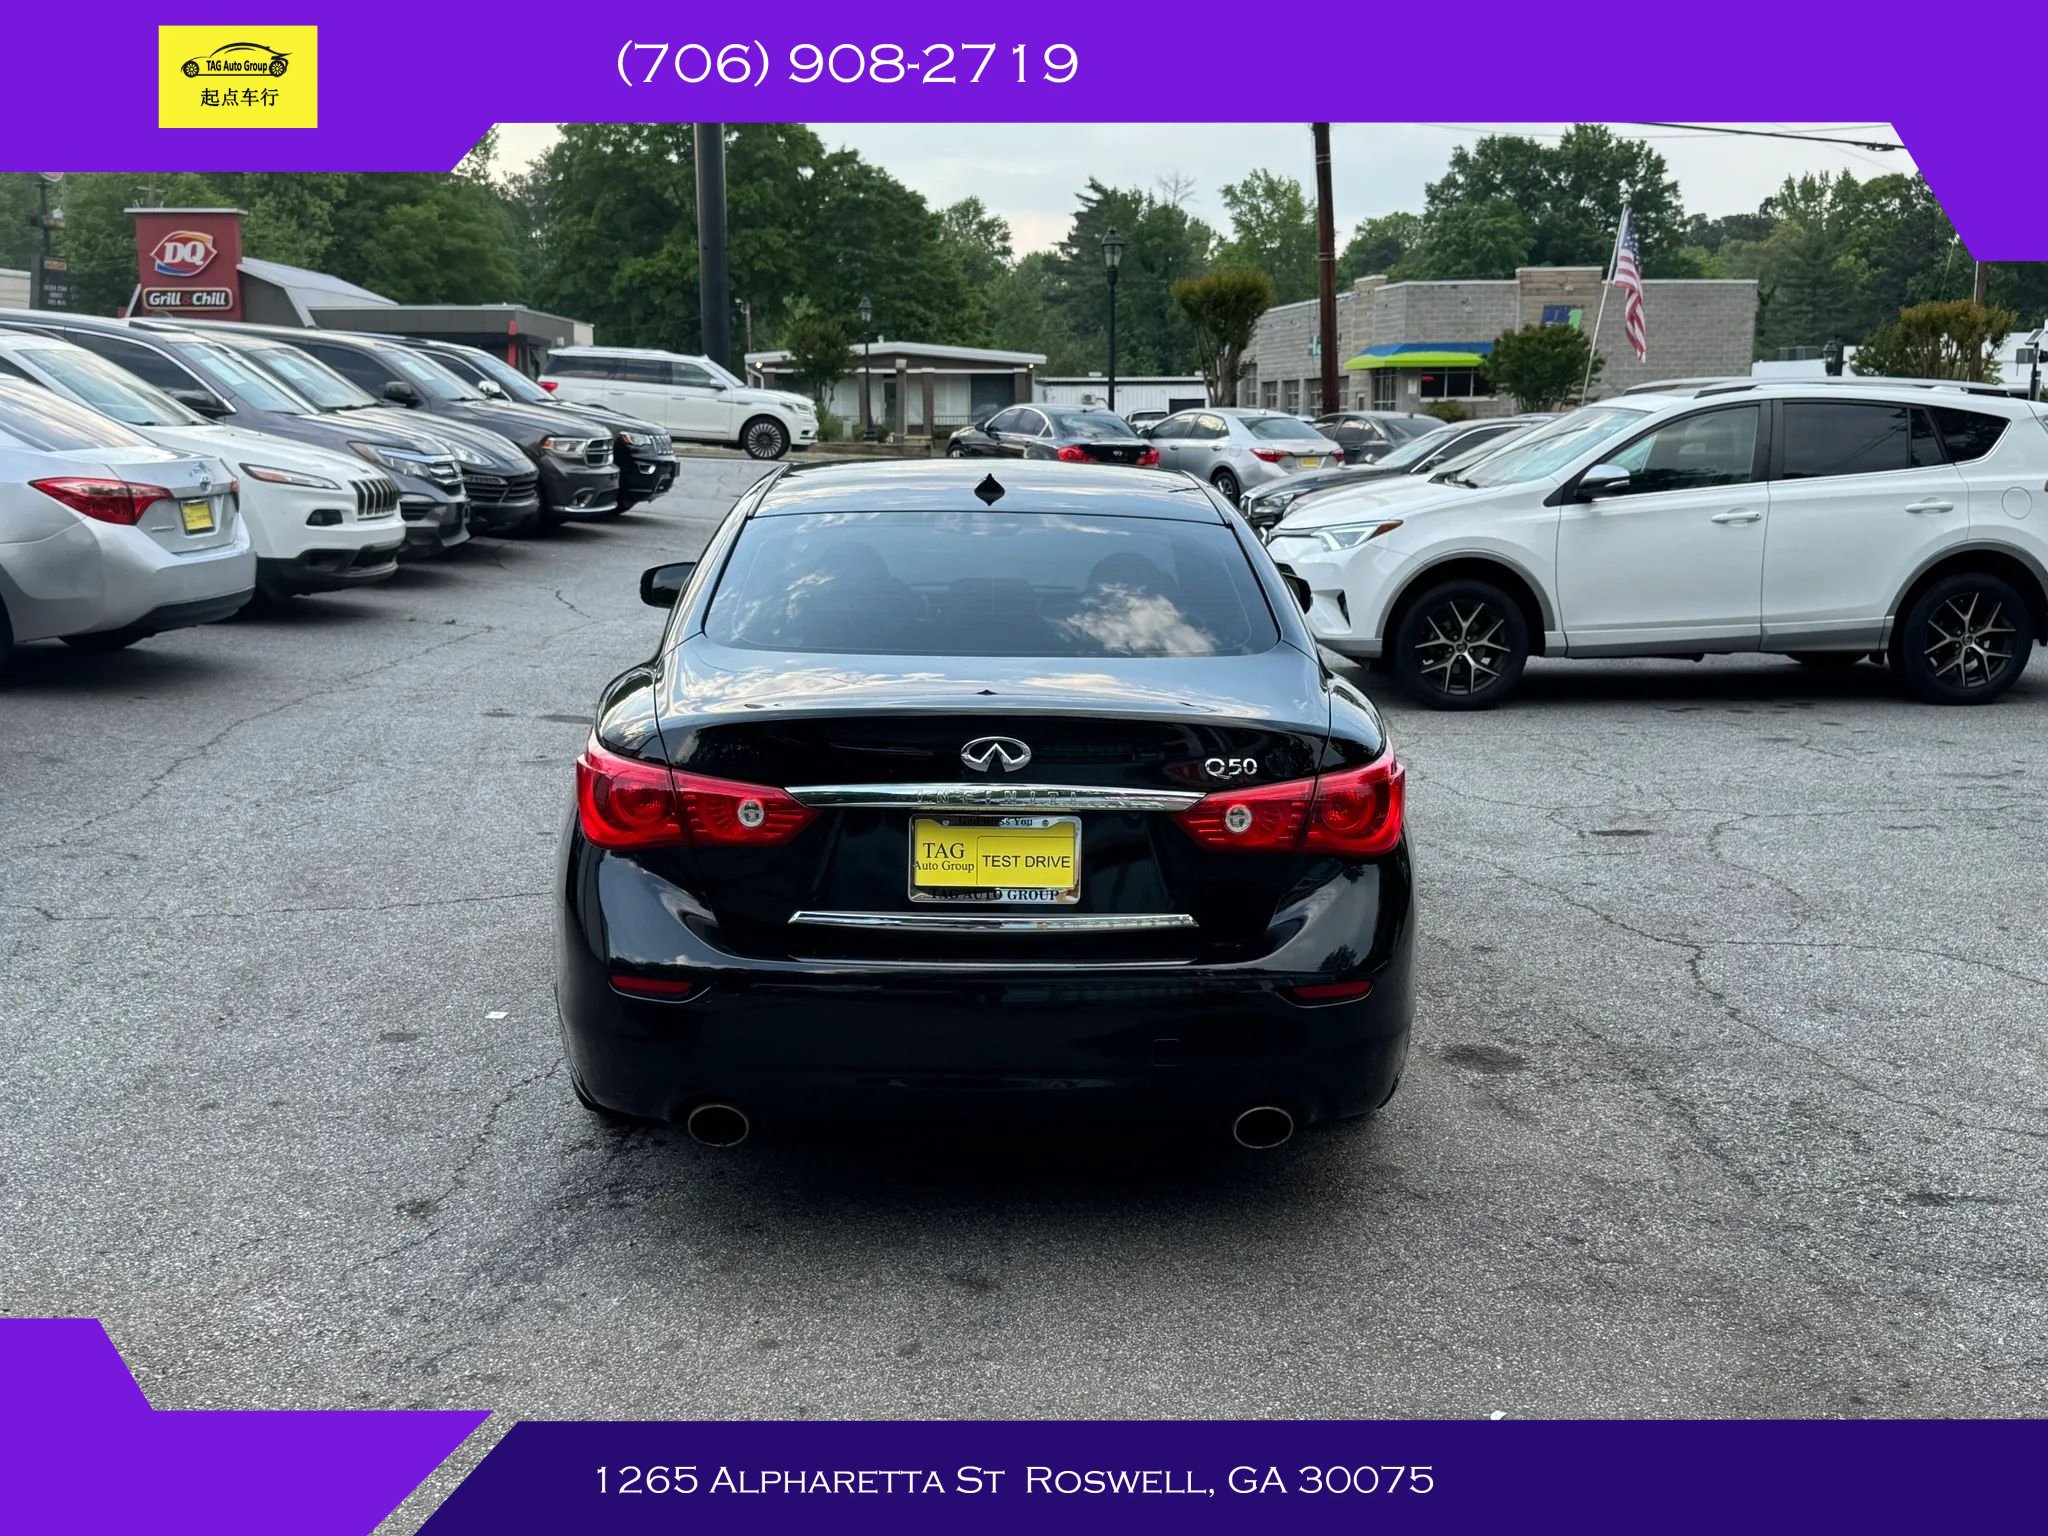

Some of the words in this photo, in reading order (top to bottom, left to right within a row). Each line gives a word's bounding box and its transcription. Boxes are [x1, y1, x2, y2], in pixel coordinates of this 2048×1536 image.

[163, 241, 206, 266] DQ
[149, 292, 181, 305] Grill
[192, 292, 226, 305] Chill
[1205, 758, 1258, 780] Q50
[916, 790, 1077, 805] INFINITI
[1014, 818, 1033, 827] You
[922, 842, 965, 859] TAG
[914, 860, 938, 871] Auto
[941, 860, 975, 873] Group
[981, 855, 1021, 868] TEST
[1025, 855, 1071, 868] DRIVE
[931, 888, 959, 900] TAG
[963, 889, 1003, 900] AUTO
[1007, 889, 1060, 901] GROUP
